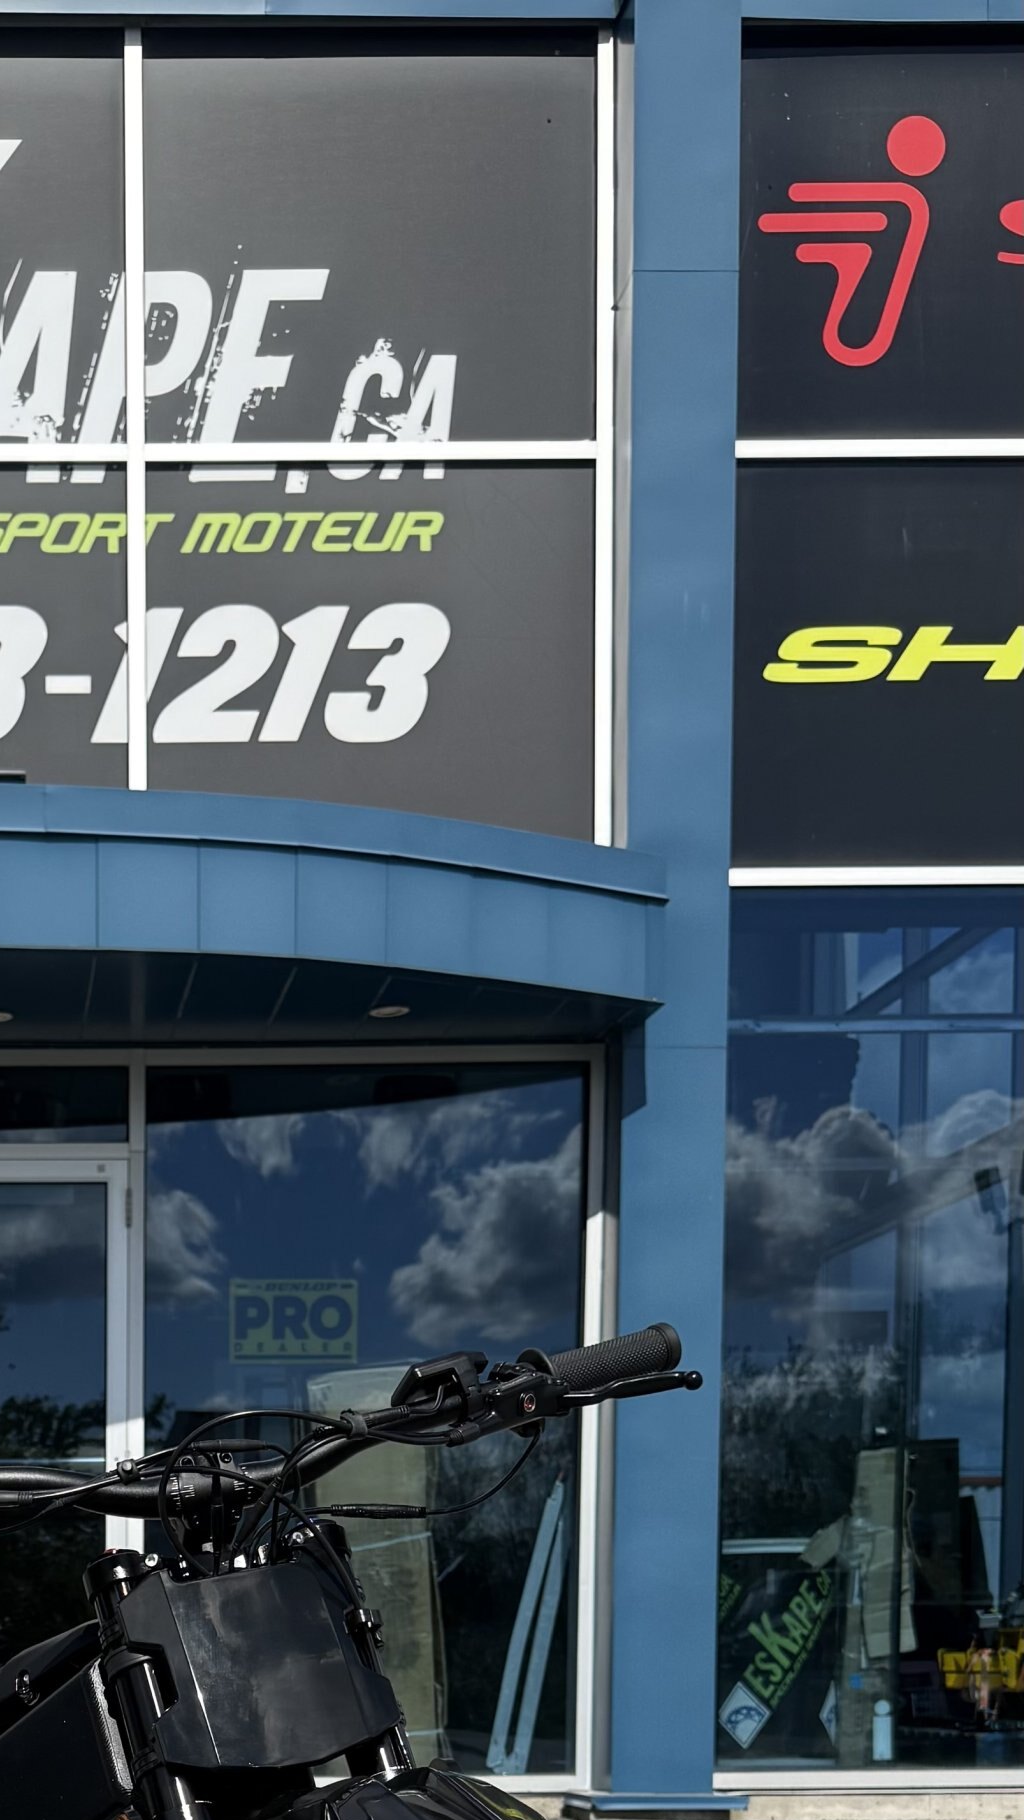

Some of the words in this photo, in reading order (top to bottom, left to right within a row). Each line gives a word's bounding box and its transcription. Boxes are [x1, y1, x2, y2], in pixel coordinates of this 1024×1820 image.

[180, 511, 445, 553] MOTEUR
[265, 1282, 337, 1292] DUNLOP
[235, 1295, 353, 1340] PRO
[234, 1342, 352, 1352] DEALER
